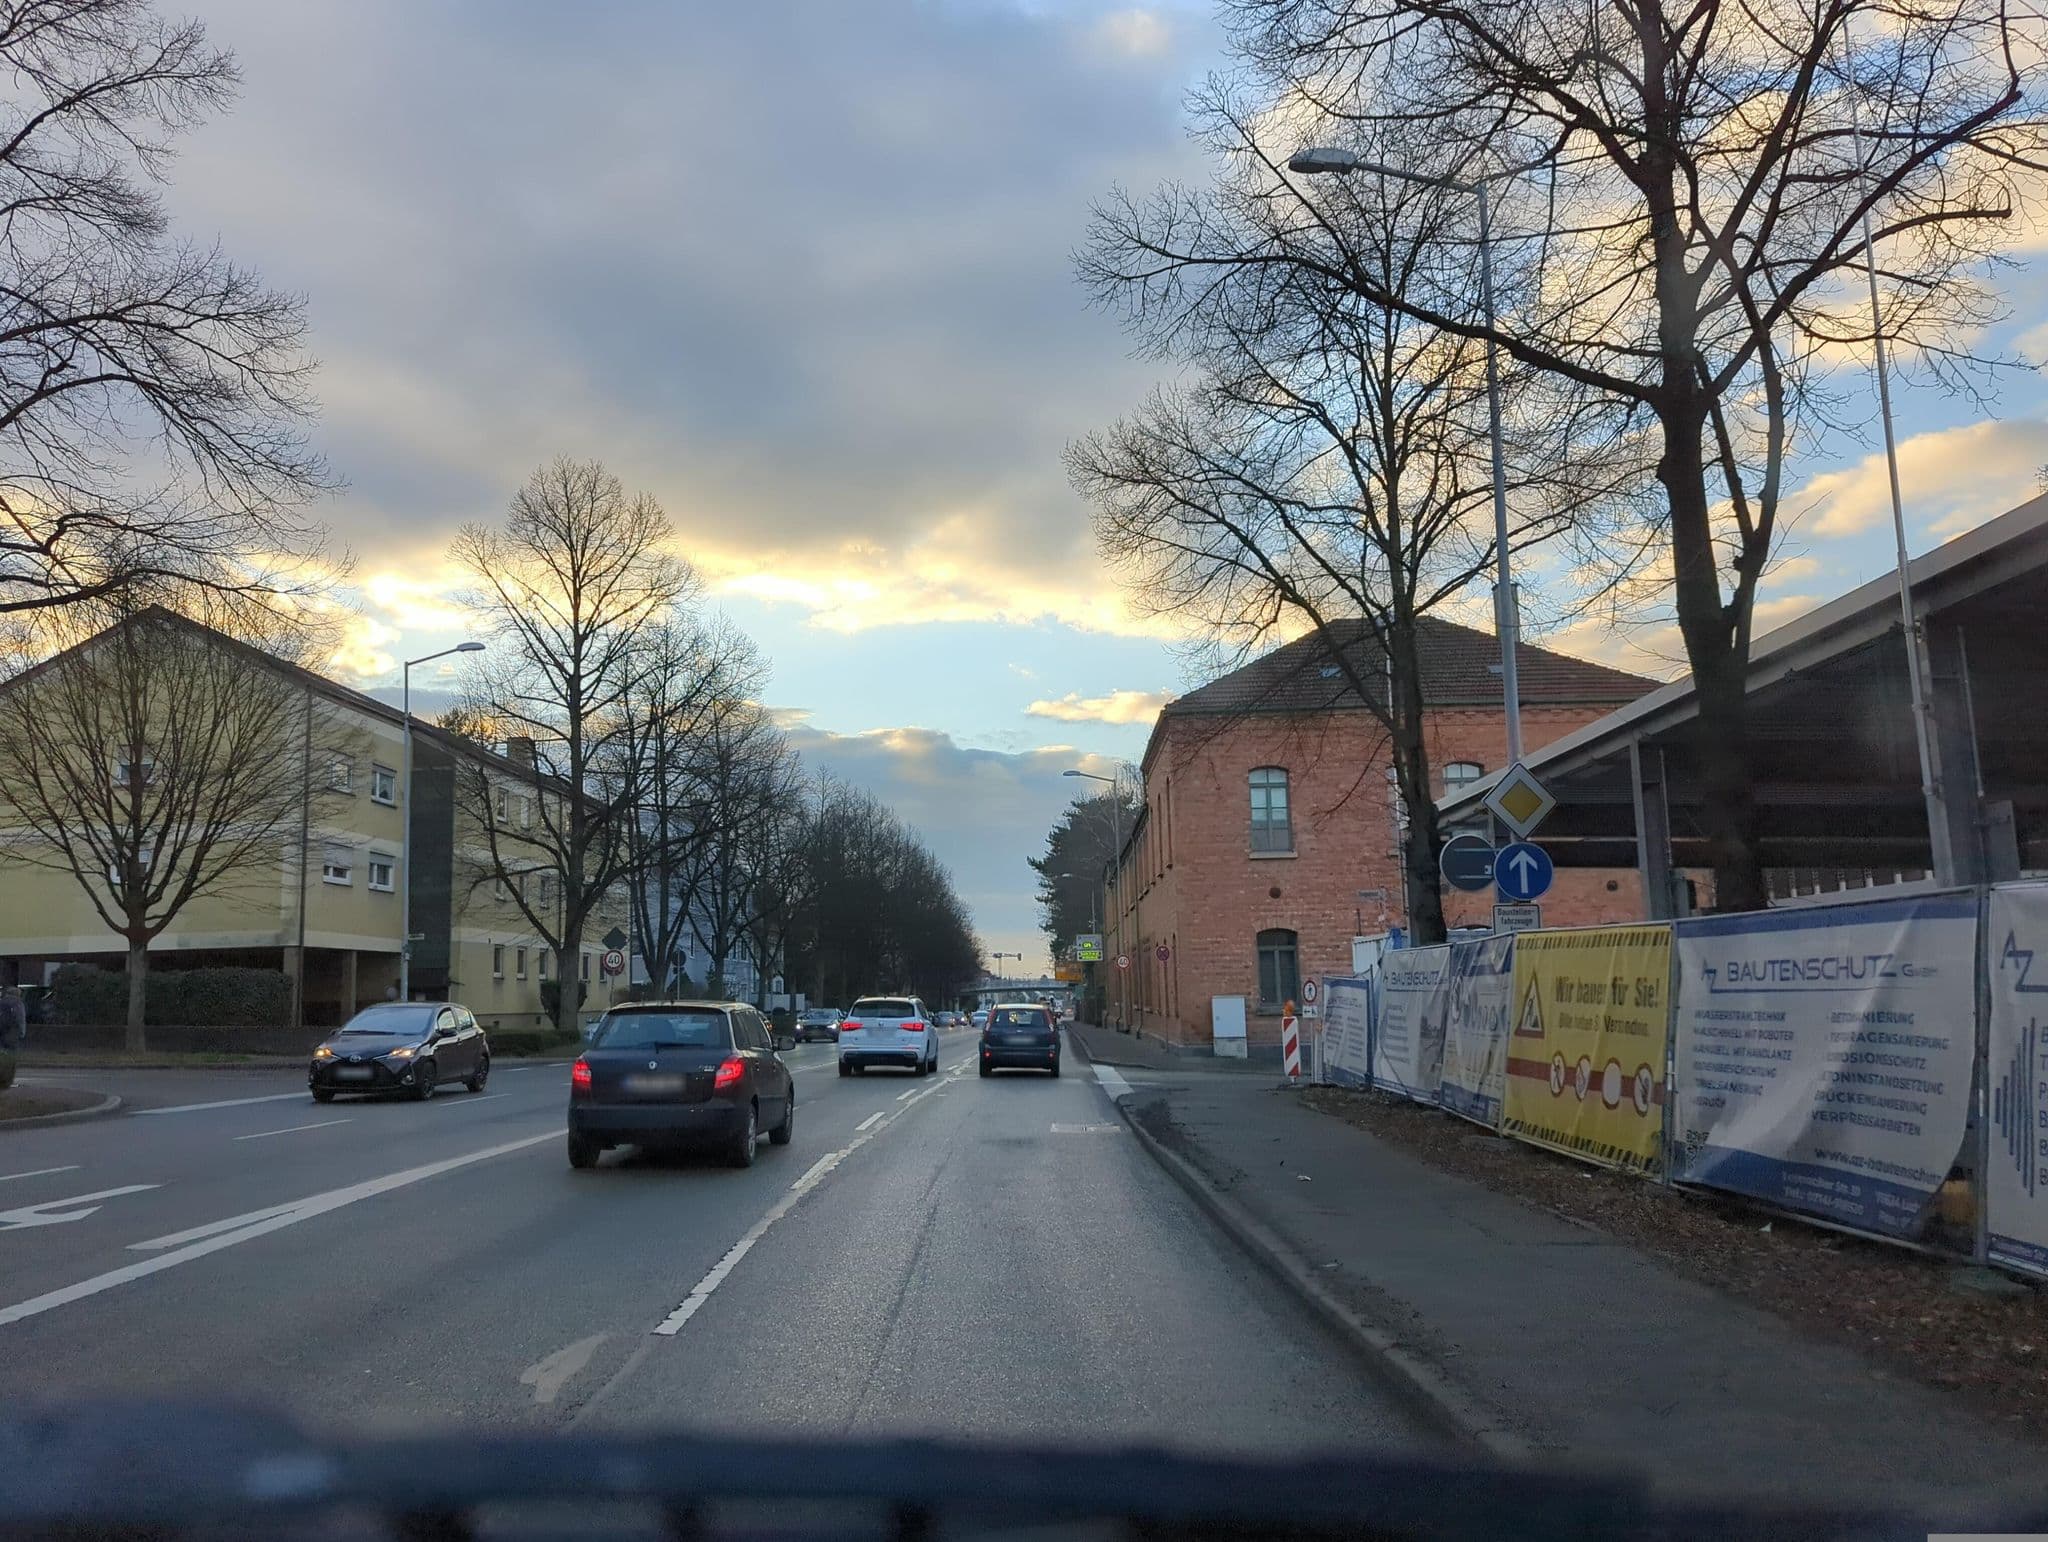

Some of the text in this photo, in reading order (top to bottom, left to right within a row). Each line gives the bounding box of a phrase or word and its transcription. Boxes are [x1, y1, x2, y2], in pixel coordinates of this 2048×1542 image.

[608, 954, 620, 965] 40
[1119, 957, 1128, 965] 40
[1727, 954, 1897, 982] BAUTENSCHUTZ
[2001, 929, 2032, 992] AZ
[1555, 976, 1574, 1004] Wir
[1612, 976, 1629, 1006] für
[1634, 976, 1660, 1009] Sie!
[1758, 1029, 1794, 1041] ROBOTER
[1811, 1109, 1922, 1137] VERPRESSARBEITEN
